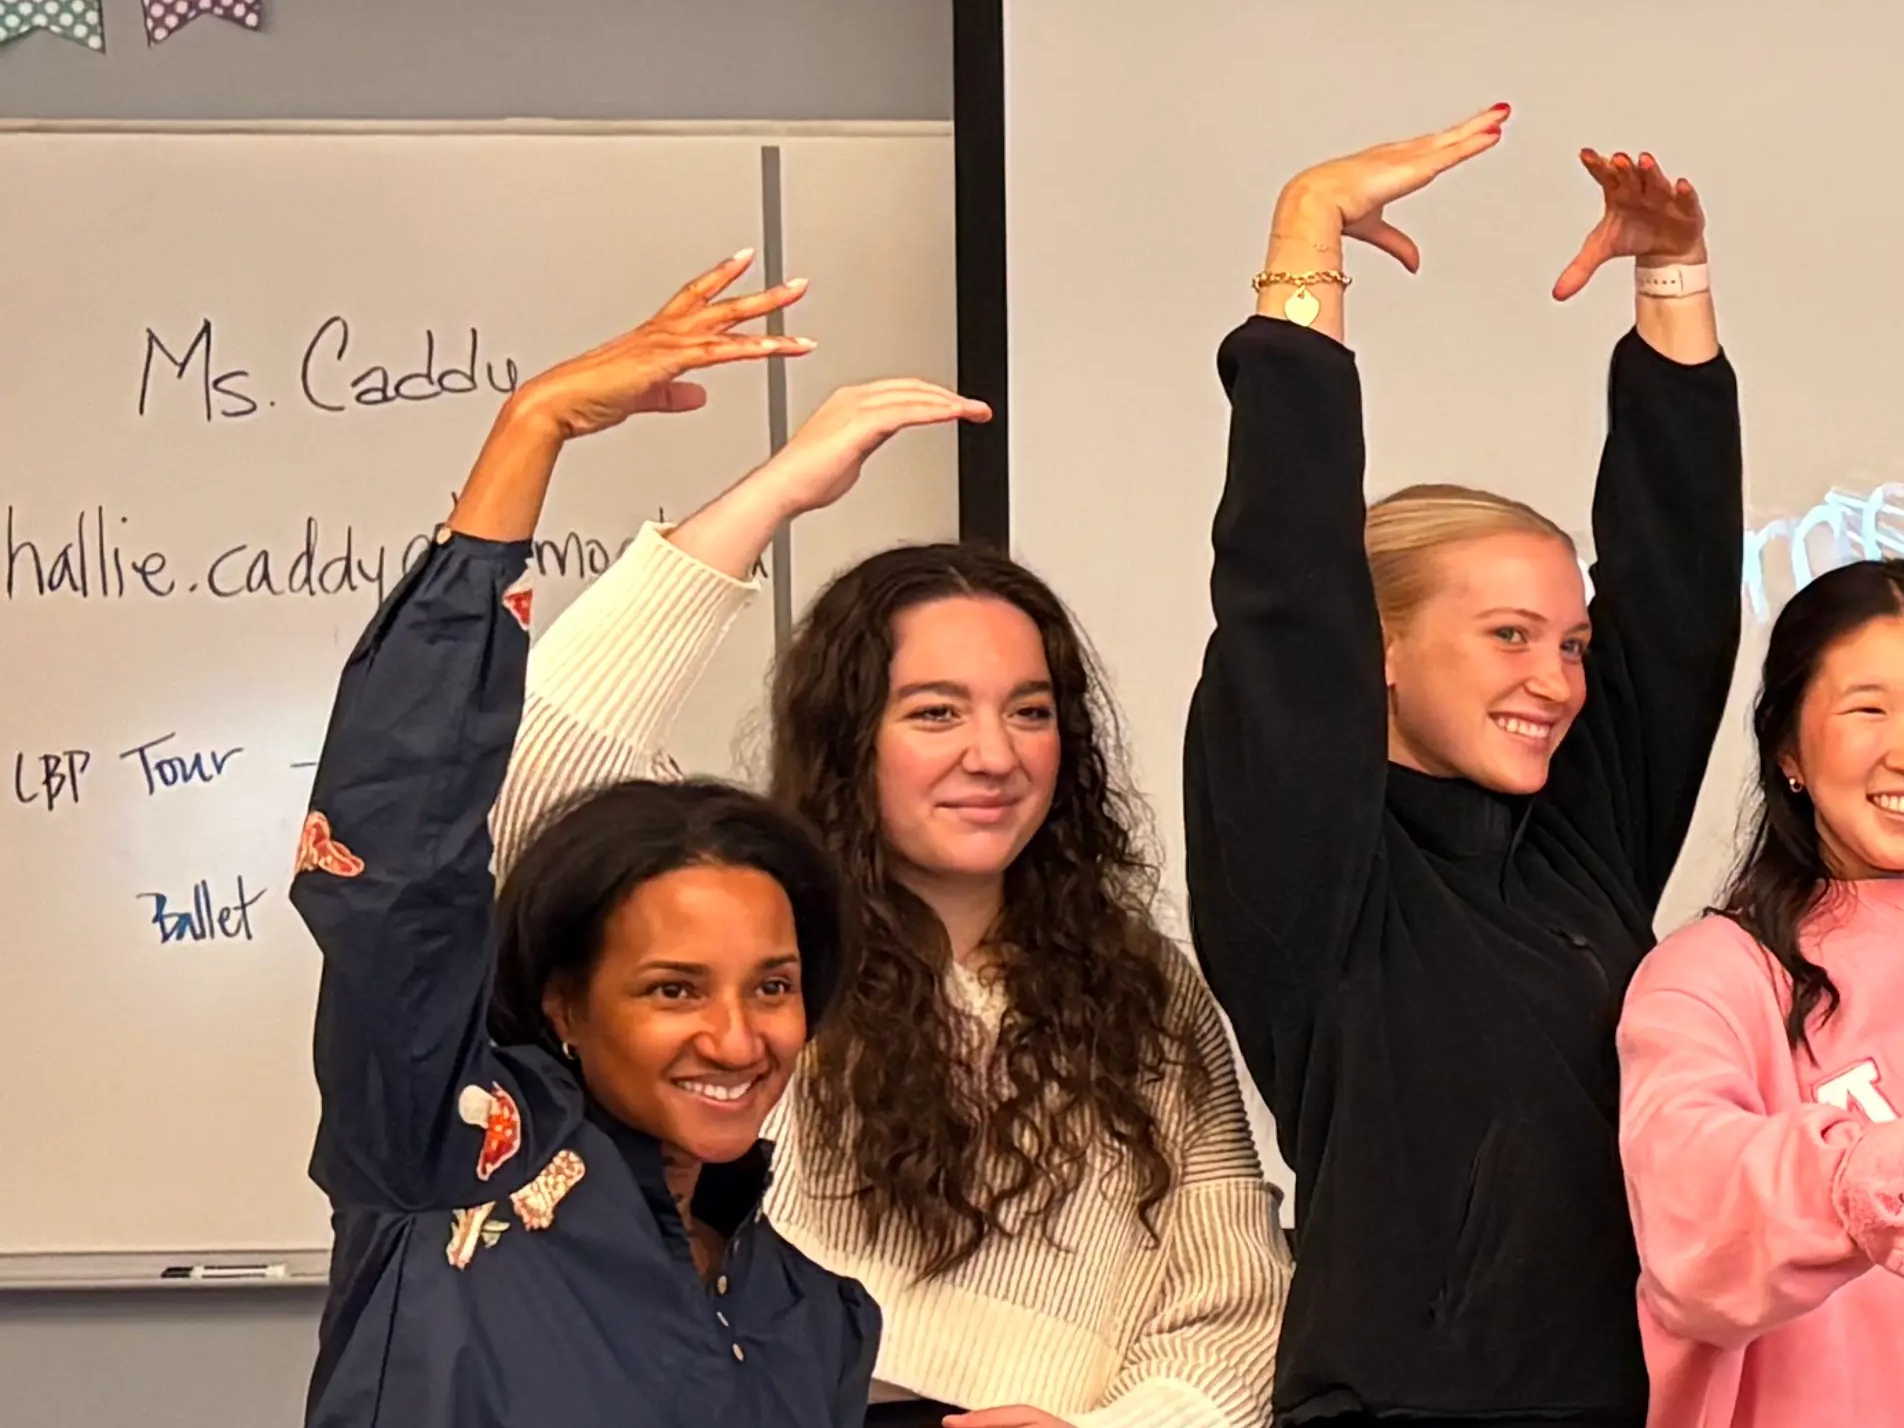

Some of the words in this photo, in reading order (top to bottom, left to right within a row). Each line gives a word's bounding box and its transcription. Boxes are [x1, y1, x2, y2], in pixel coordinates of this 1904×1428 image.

[138, 316, 276, 422] Ms.
[119, 731, 245, 797] Tour
[135, 874, 268, 944] Ballet
